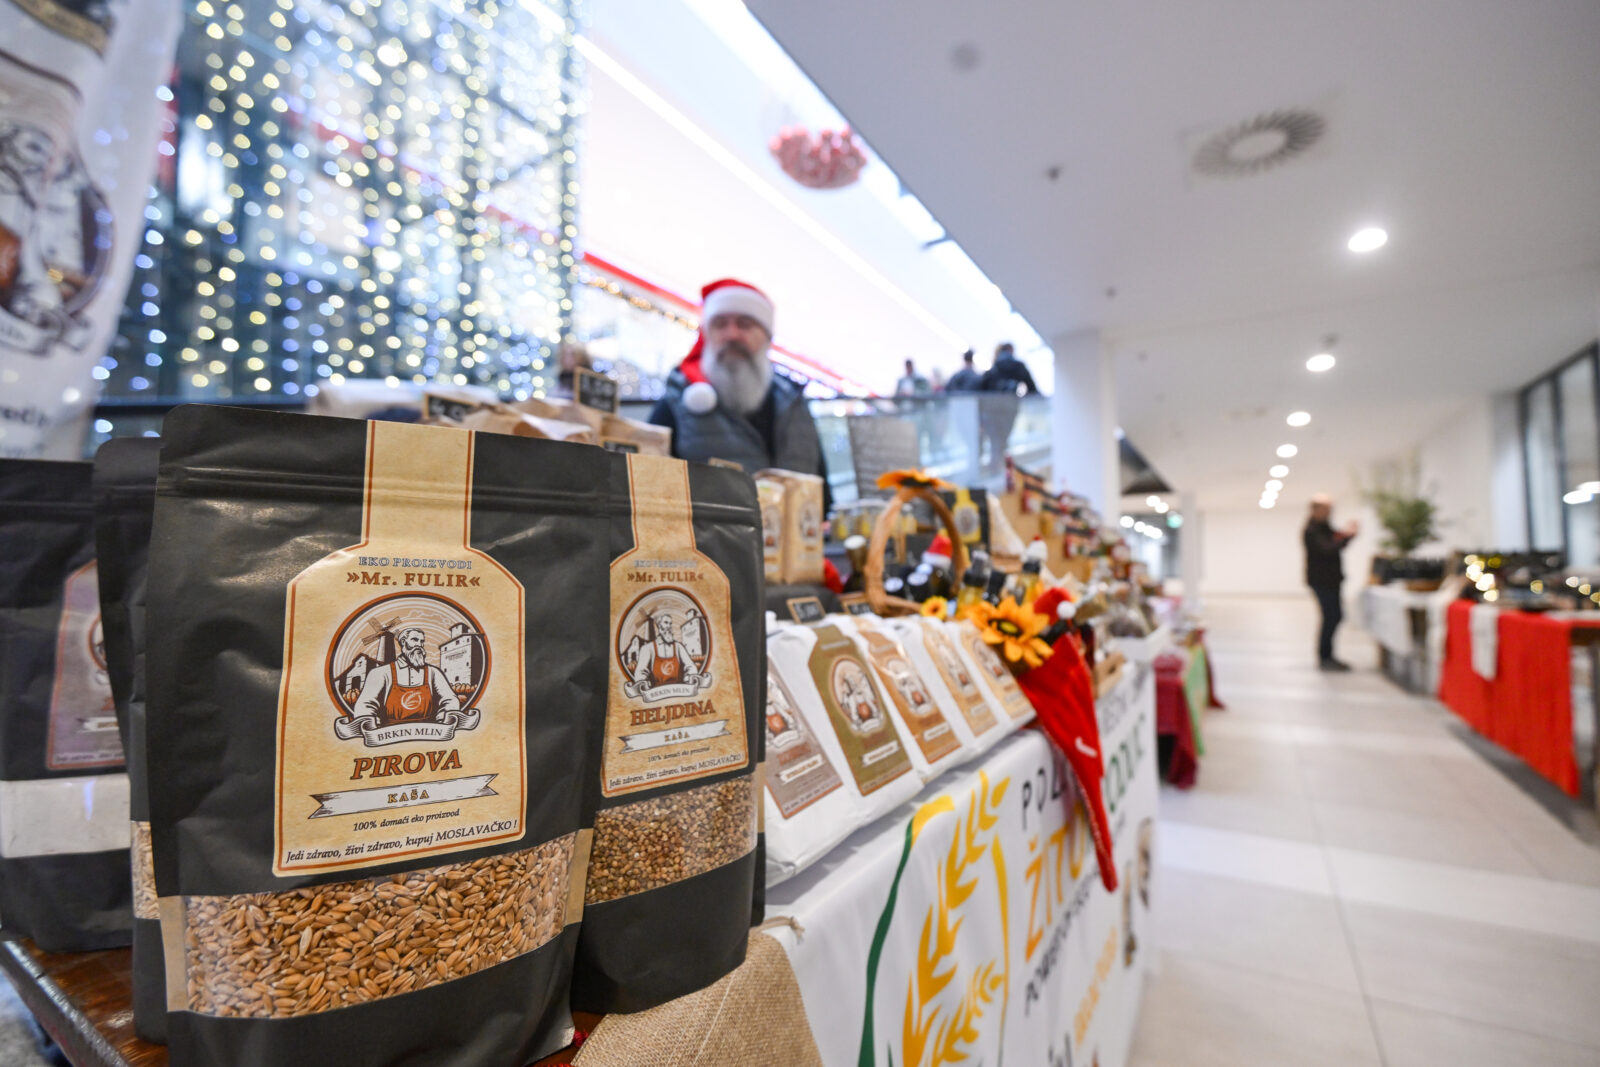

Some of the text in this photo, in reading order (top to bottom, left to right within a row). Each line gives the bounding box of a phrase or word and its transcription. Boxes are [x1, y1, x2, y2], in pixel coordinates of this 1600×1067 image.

[359, 556, 473, 570] EKO PROIZVODI
[630, 699, 716, 727] HELJDINA
[377, 728, 443, 741] BRKIN MLIN
[350, 749, 463, 781] PIROVA
[388, 789, 430, 804] KAŠA
[353, 808, 460, 832] 100% domaći eko proizvod
[285, 850, 304, 864] Jedi
[306, 849, 342, 860] zdravo,
[345, 843, 365, 856] živi
[367, 840, 403, 852] zdravo,
[405, 833, 434, 846] kupuj
[436, 820, 512, 842] MOSLAVAČKO
